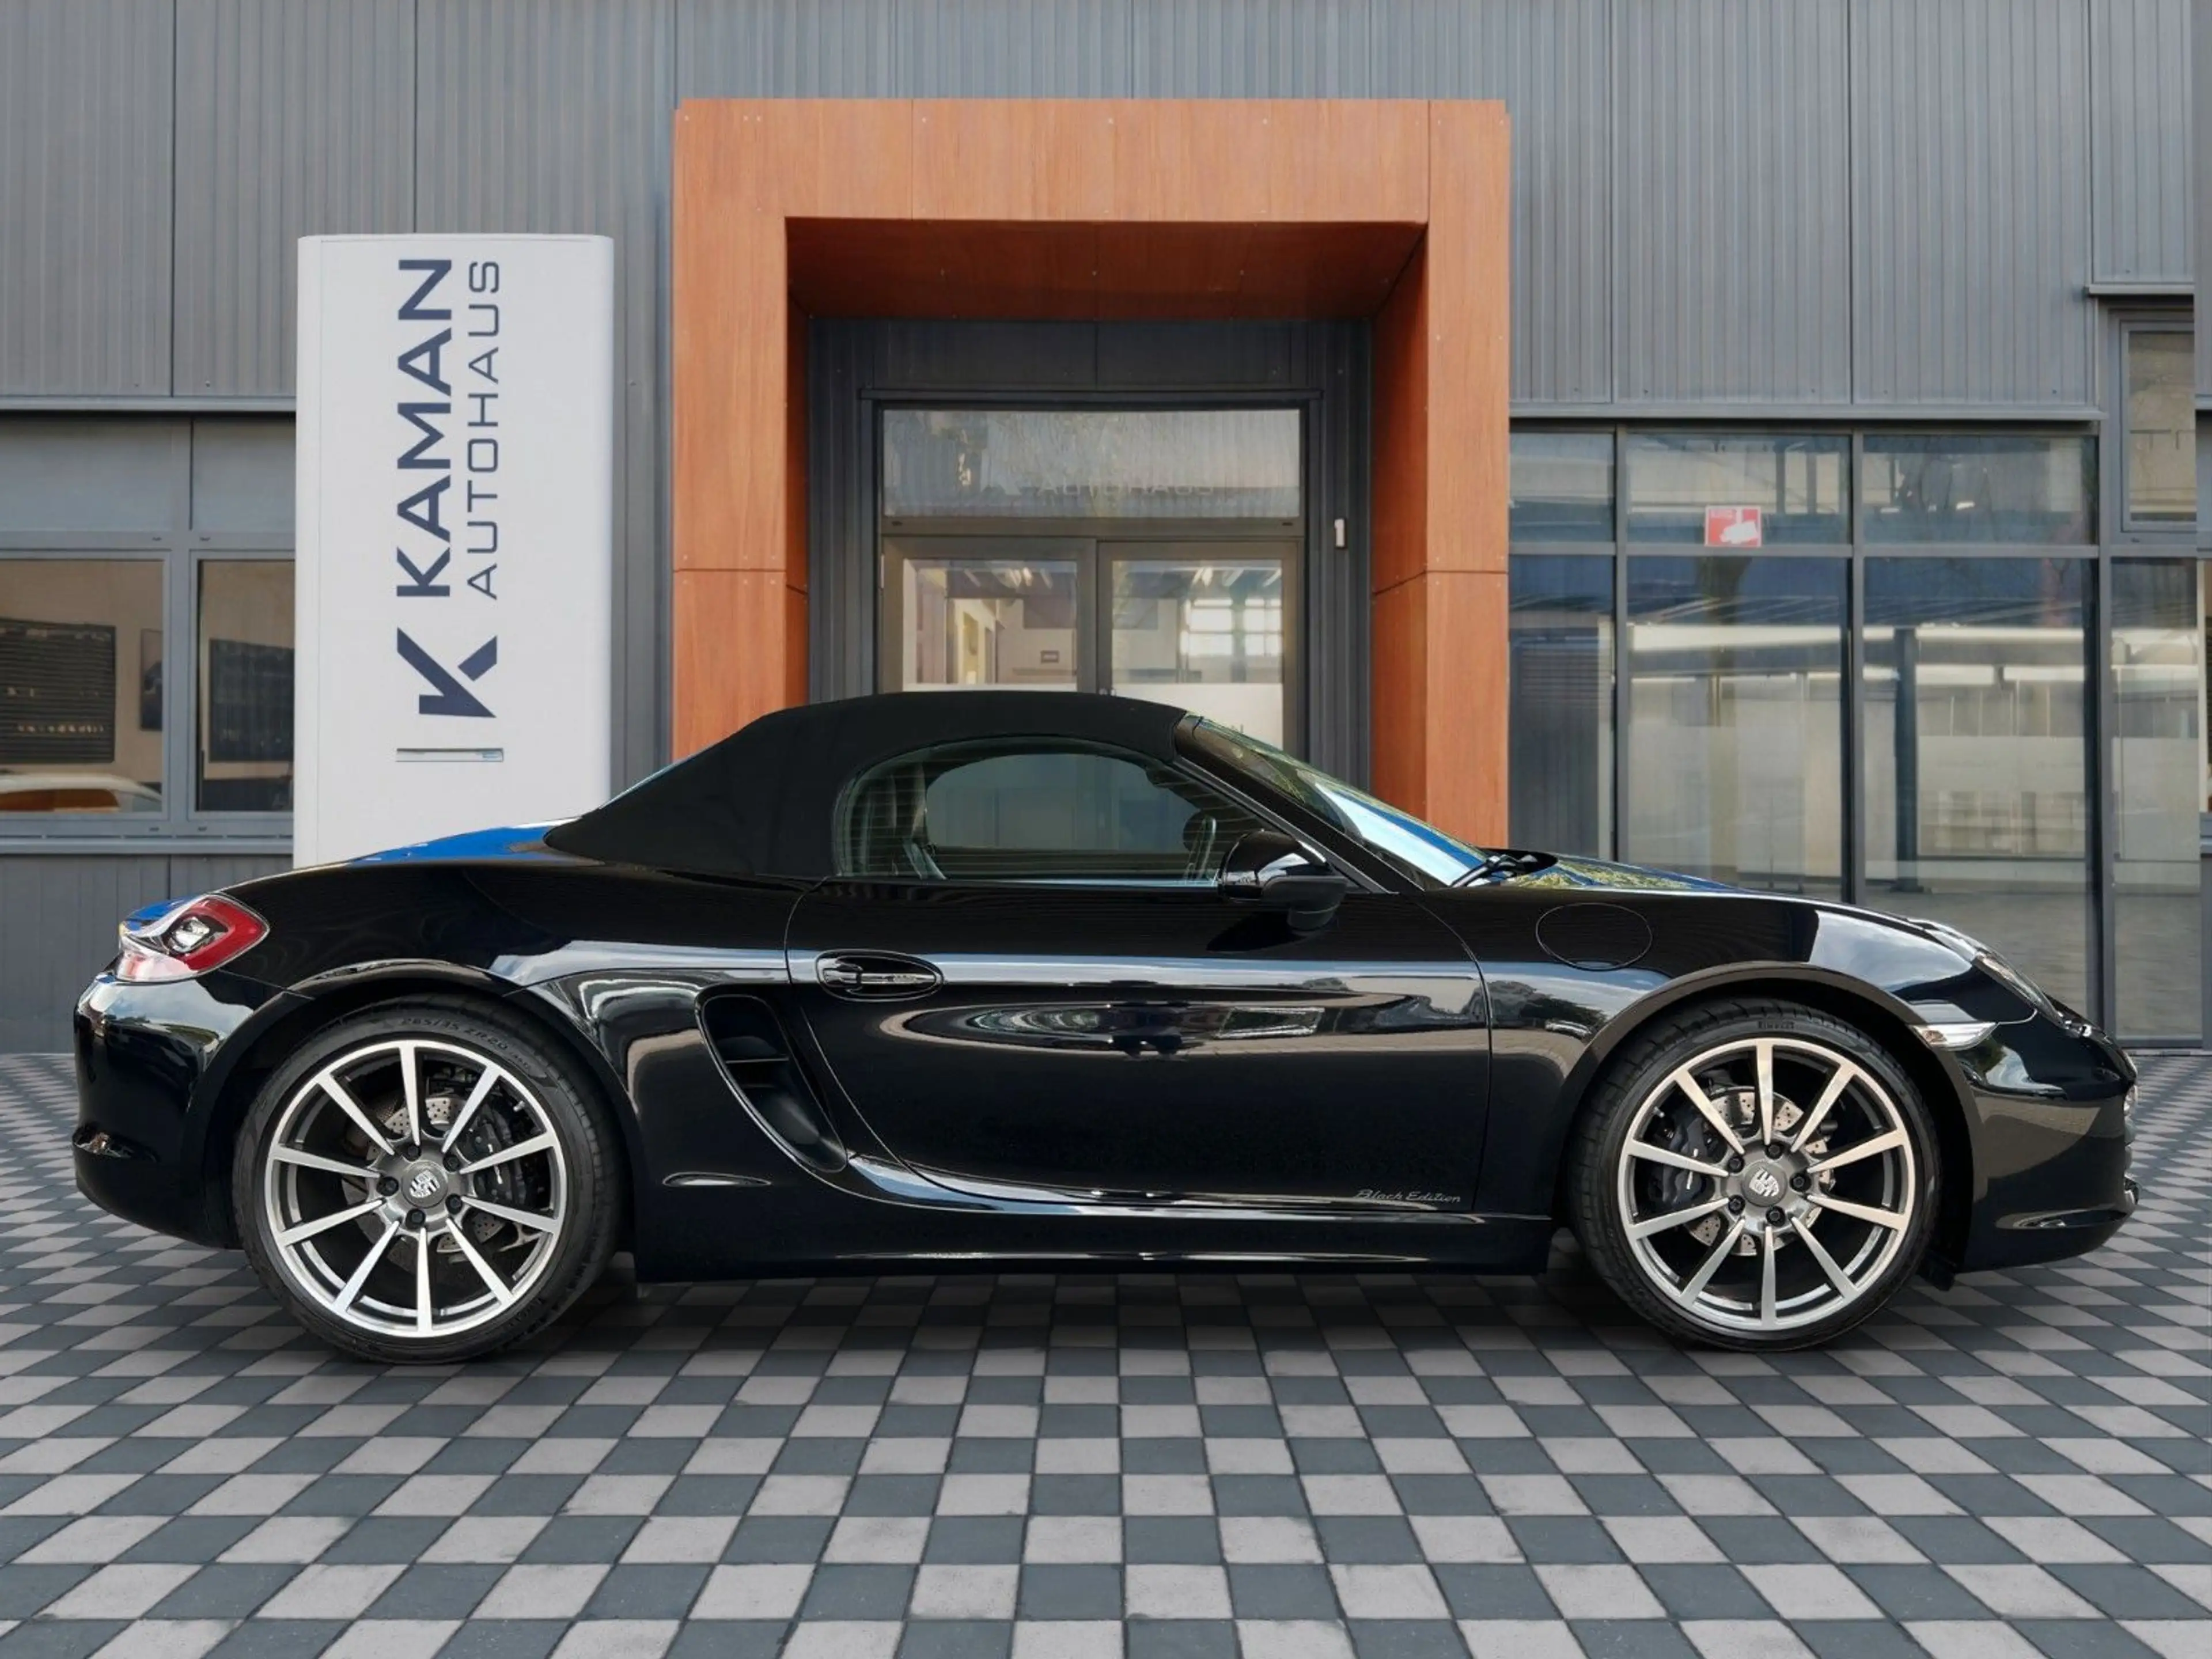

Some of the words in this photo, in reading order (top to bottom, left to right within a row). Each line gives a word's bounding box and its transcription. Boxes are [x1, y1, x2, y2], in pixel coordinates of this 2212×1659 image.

[397, 260, 452, 597] KAMAN
[467, 262, 499, 600] AUTOHAUS
[1354, 1189, 1402, 1200] Black
[1406, 1191, 1461, 1203] Edition
